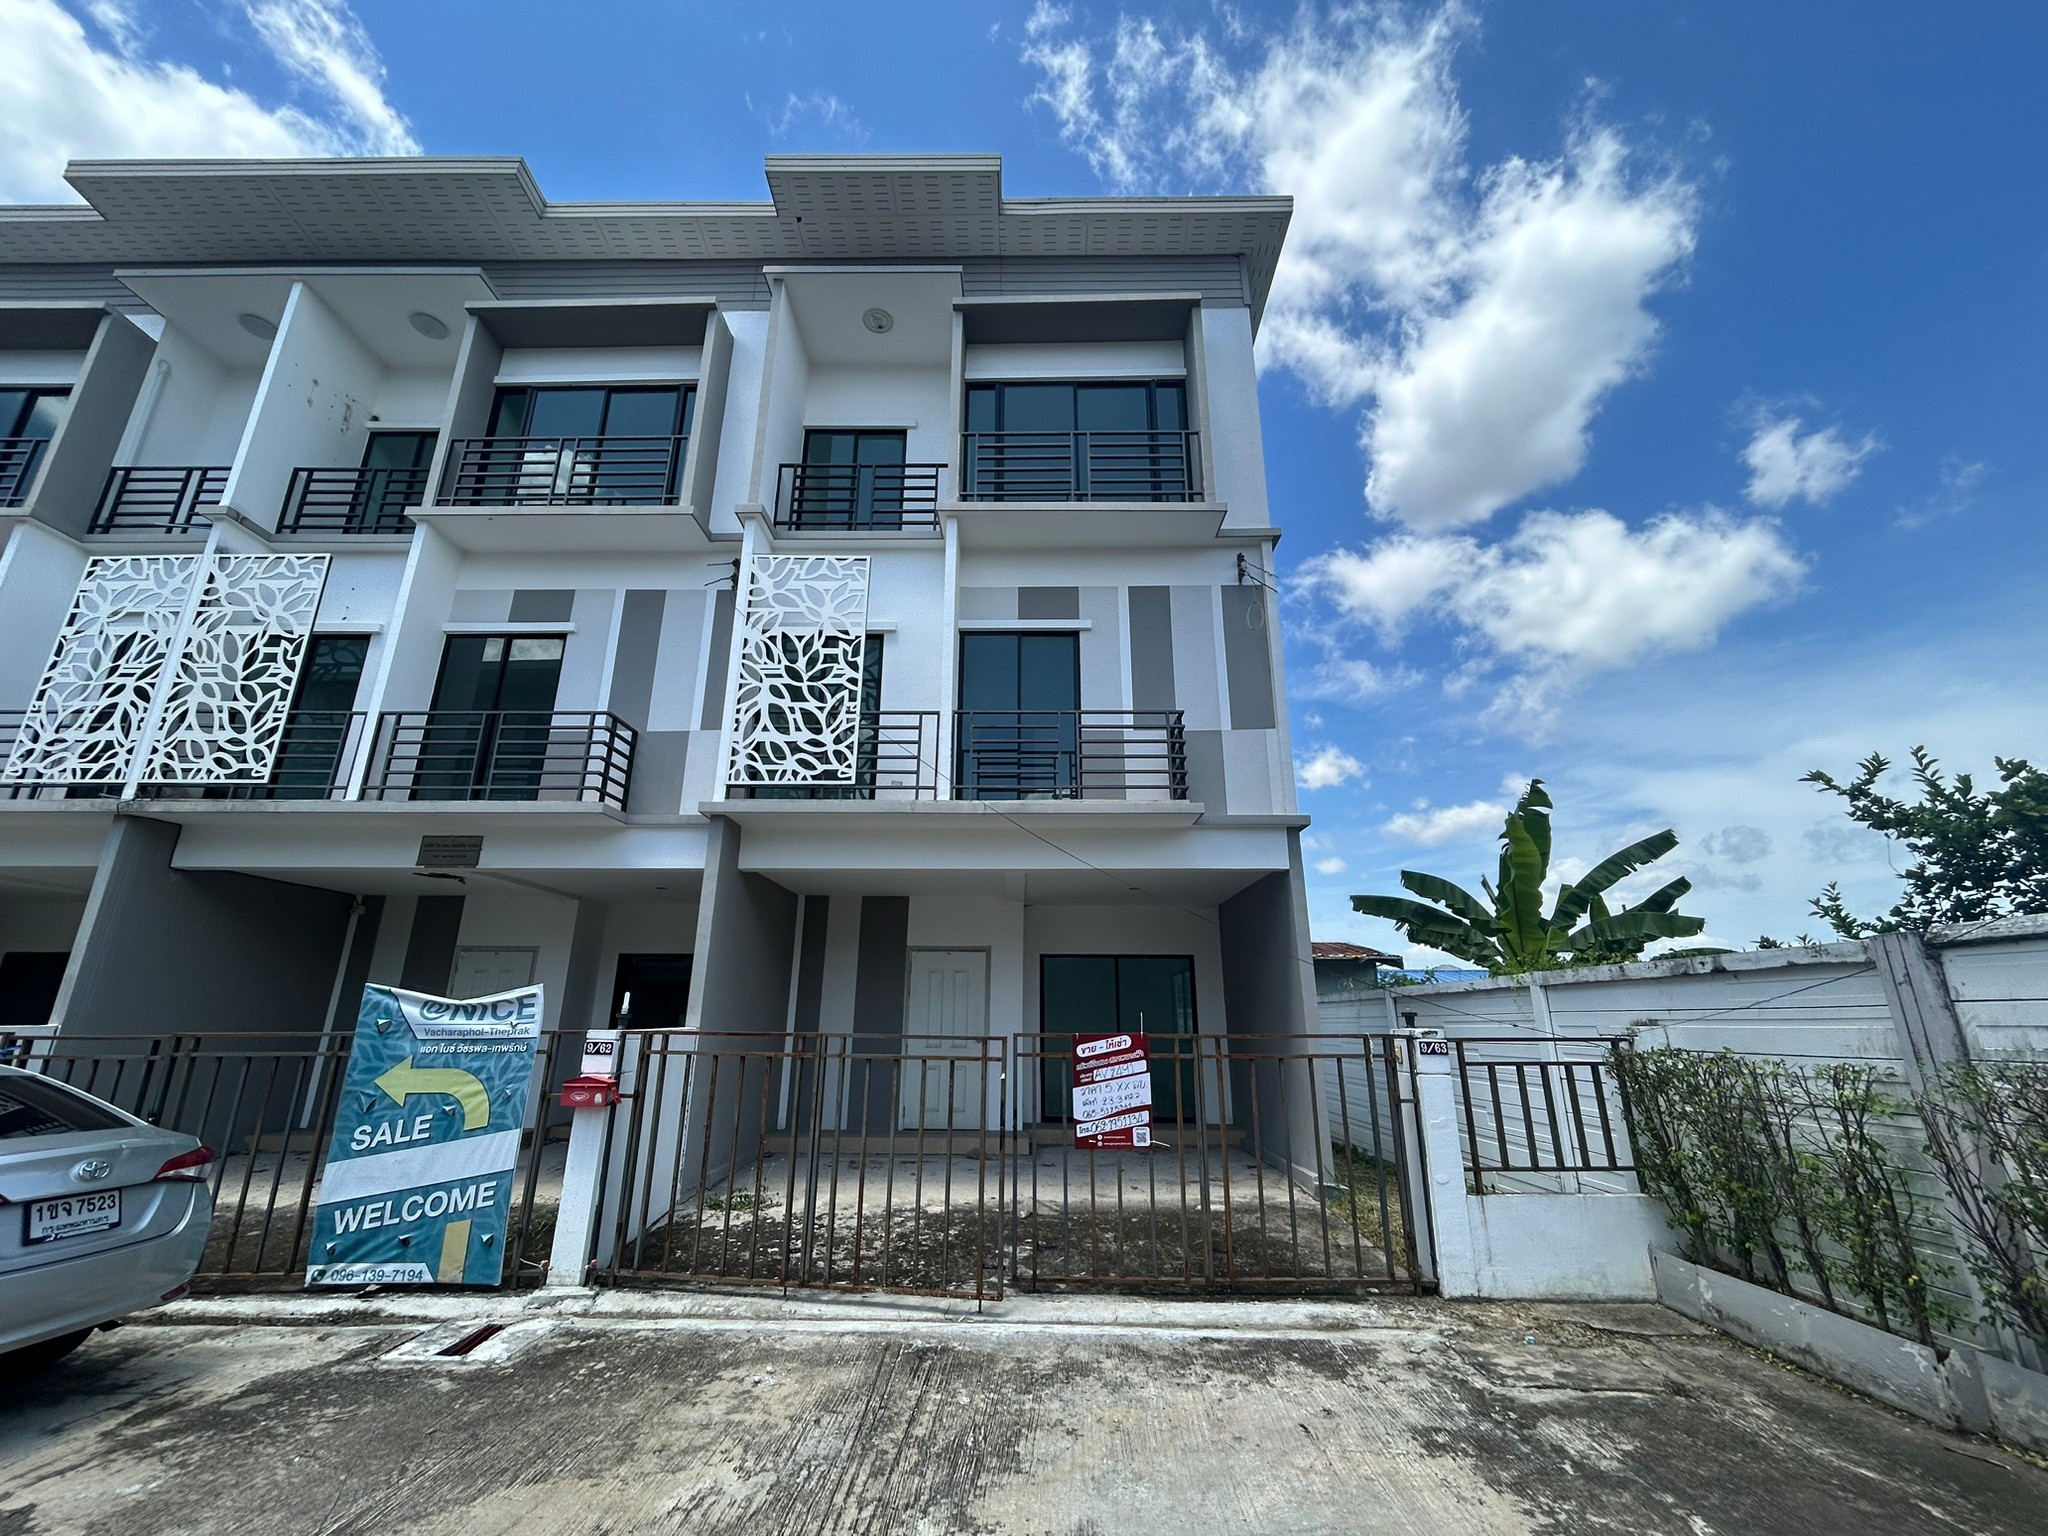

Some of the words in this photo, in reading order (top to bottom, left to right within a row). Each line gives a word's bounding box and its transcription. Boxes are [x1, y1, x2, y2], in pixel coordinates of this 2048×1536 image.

[419, 993, 537, 1021] @NICE
[586, 1042, 612, 1054] 9/62
[1420, 1042, 1447, 1054] 9/63
[350, 1113, 433, 1151] SALE
[76, 1194, 116, 1215] 7523
[333, 1180, 498, 1235] WELCOME
[330, 1269, 424, 1282] 096-139-7194
